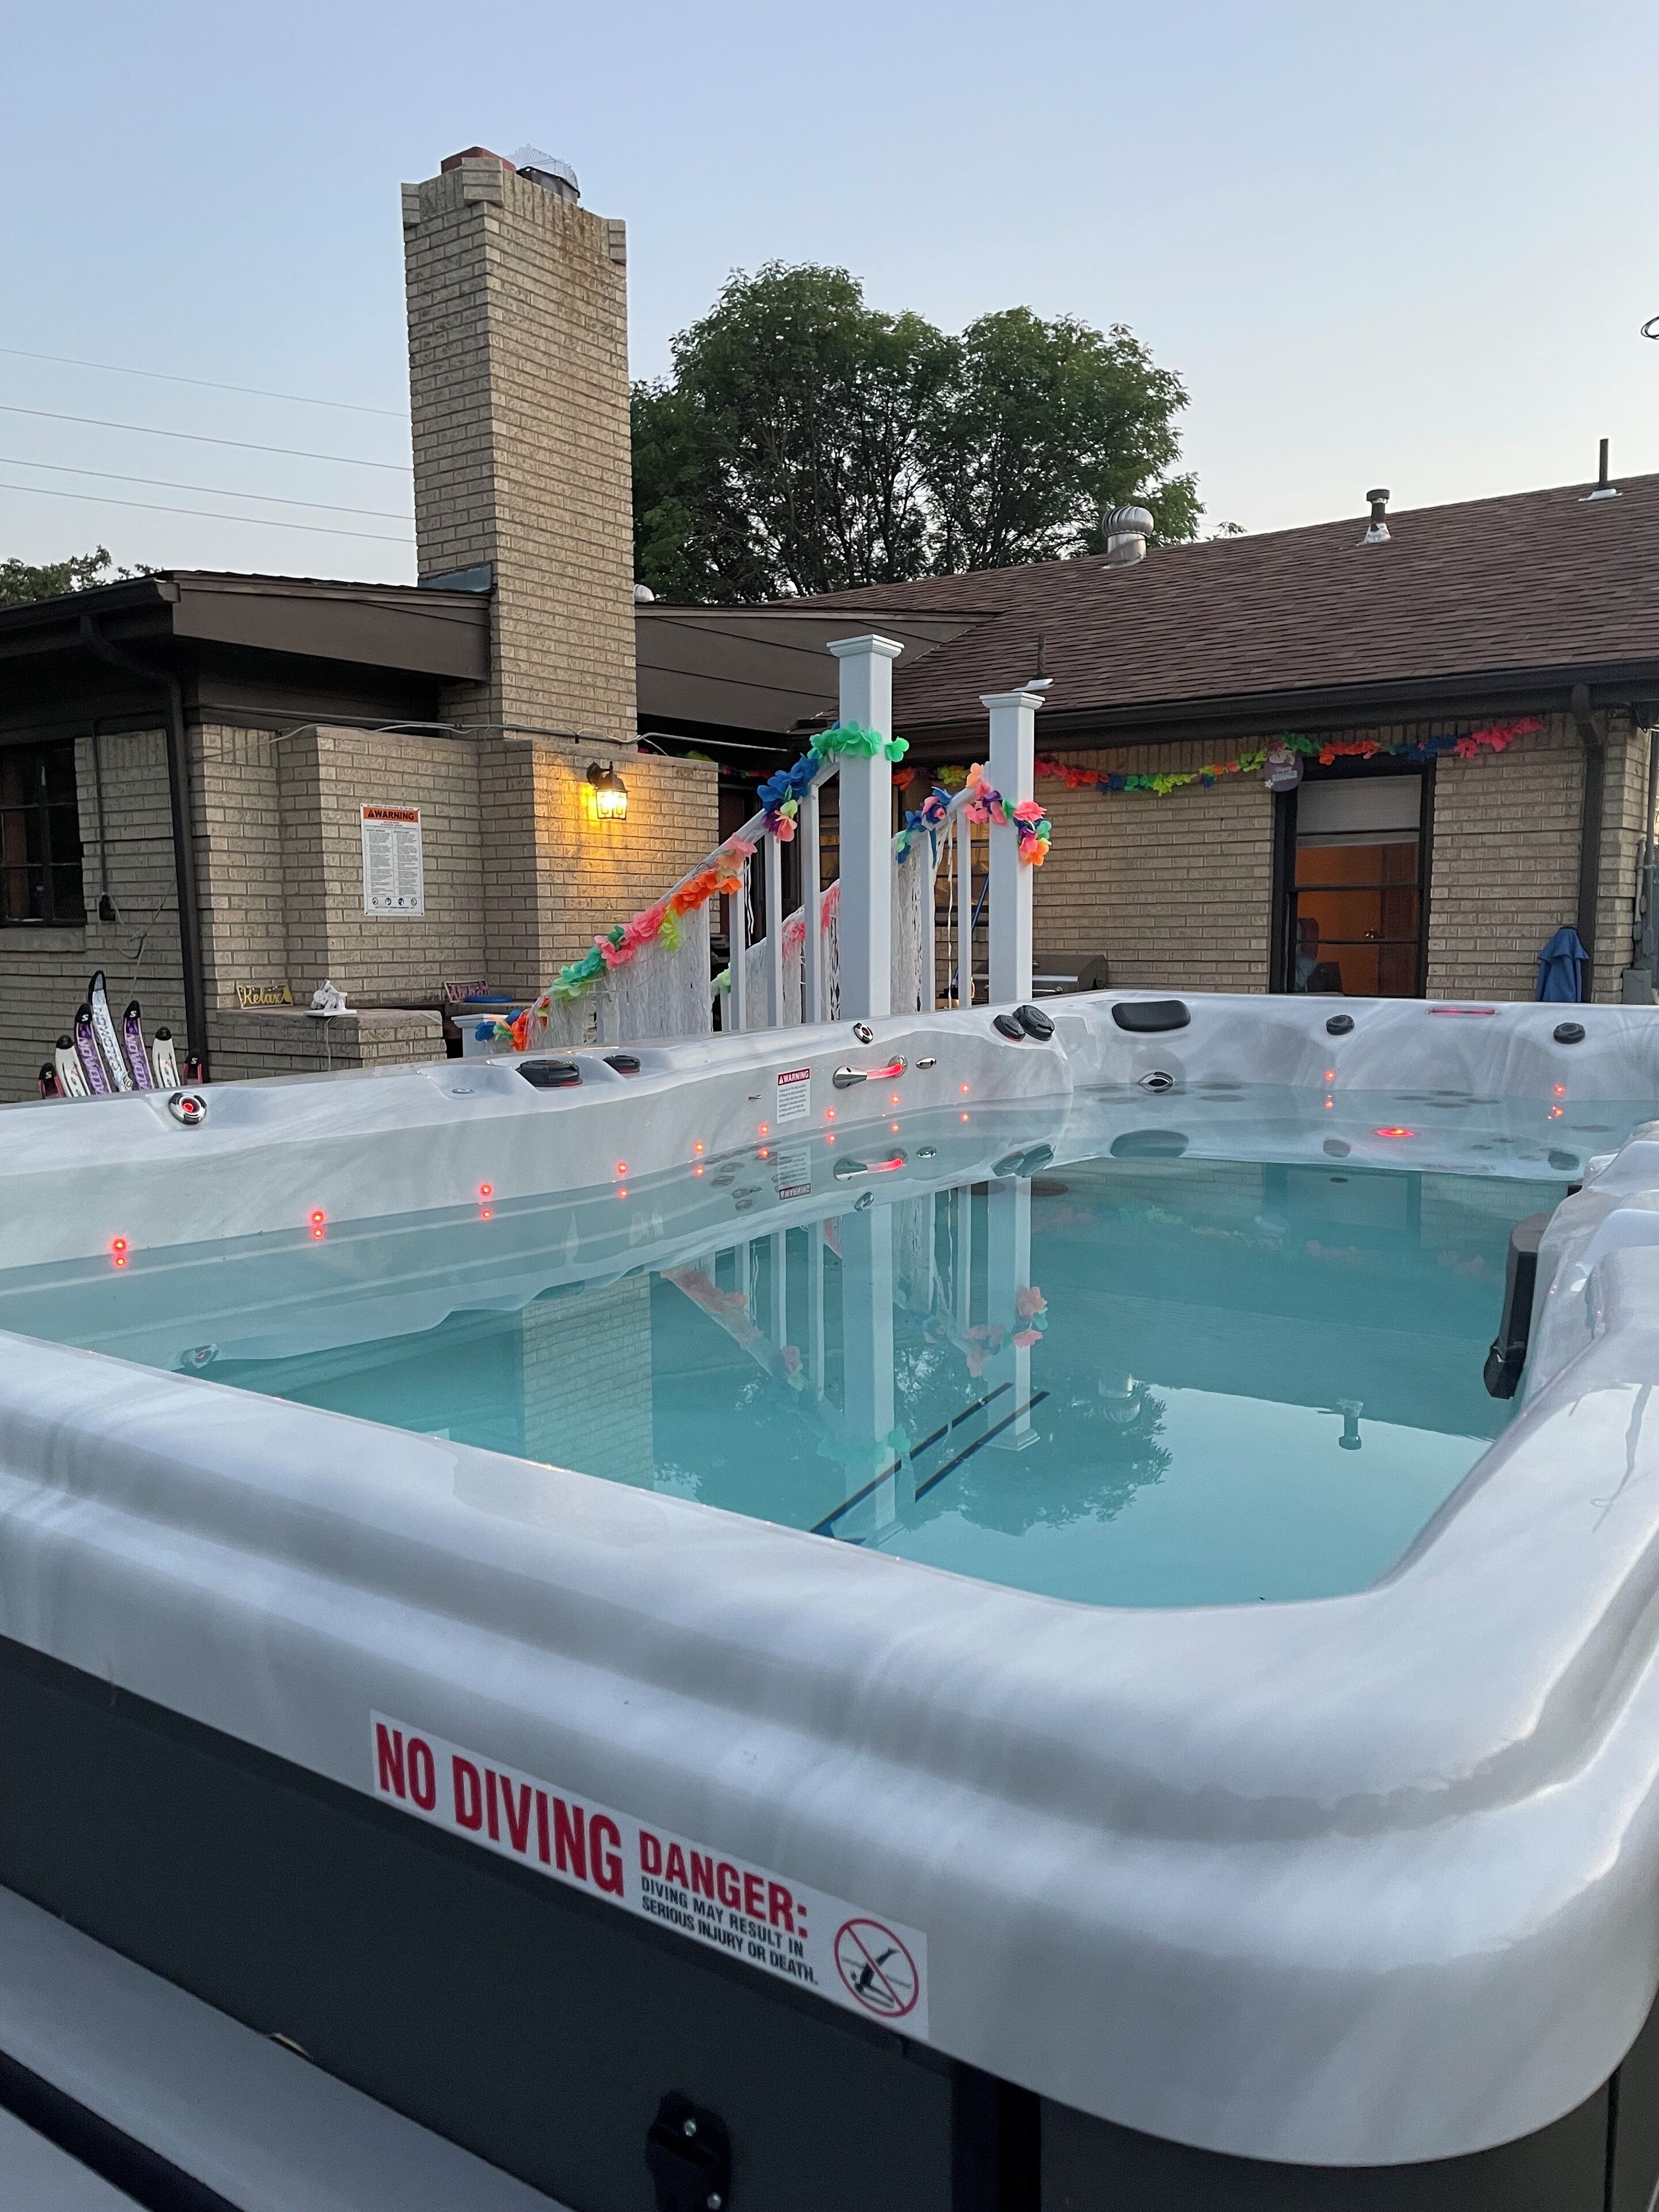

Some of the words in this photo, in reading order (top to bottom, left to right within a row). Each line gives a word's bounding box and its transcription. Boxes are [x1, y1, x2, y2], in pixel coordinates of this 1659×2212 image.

[374, 809, 414, 820] WARNING
[241, 986, 283, 1005] Relax
[78, 1037, 105, 1094] ALOMON
[126, 1034, 151, 1090] ALOMON
[783, 1070, 809, 1084] WARNING
[376, 1723, 437, 1812] NO
[452, 1754, 625, 1899] DIVING
[639, 1828, 809, 1938] DANGER:
[642, 1876, 688, 1910] DIVING
[693, 1897, 724, 1923] MAY
[729, 1912, 784, 1950] RESULT
[787, 1936, 804, 1958] IN
[642, 1896, 695, 1931] SERIOUS
[698, 1919, 743, 1953] INJURY
[747, 1940, 766, 1963] OR
[770, 1950, 818, 1985] DEATH.
